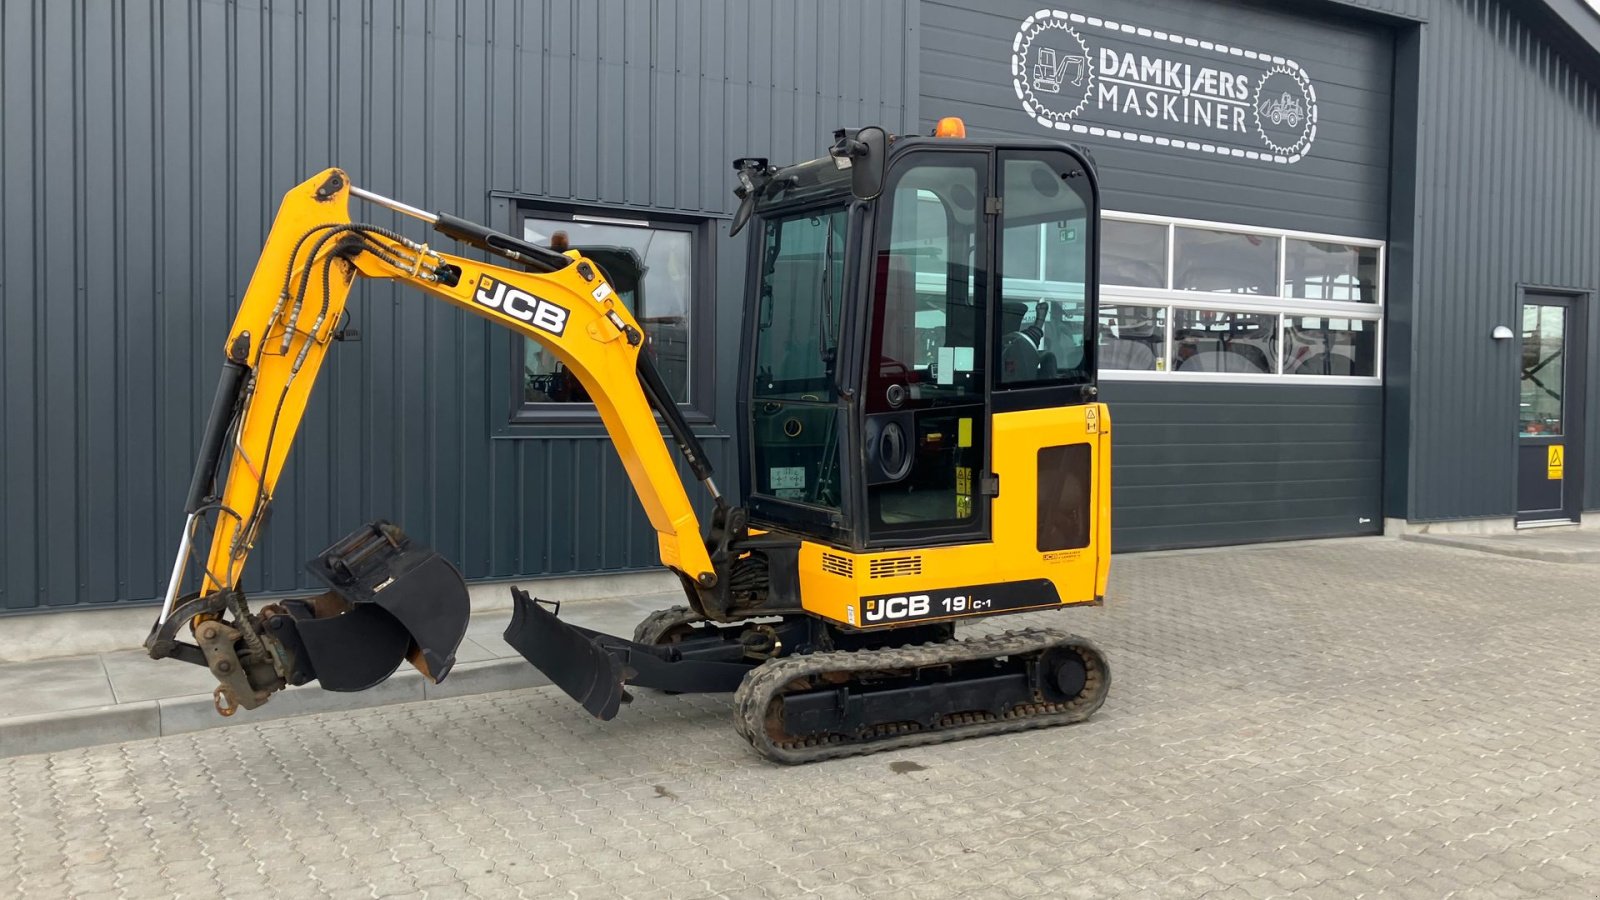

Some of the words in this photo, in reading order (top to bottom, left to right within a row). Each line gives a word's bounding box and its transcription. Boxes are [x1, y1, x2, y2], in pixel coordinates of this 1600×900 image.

[1100, 47, 1249, 100] DAMKJÆRS
[1098, 83, 1247, 133] MASKINER
[476, 282, 566, 334] JCB
[866, 595, 930, 621] JCB
[941, 596, 966, 612] 19
